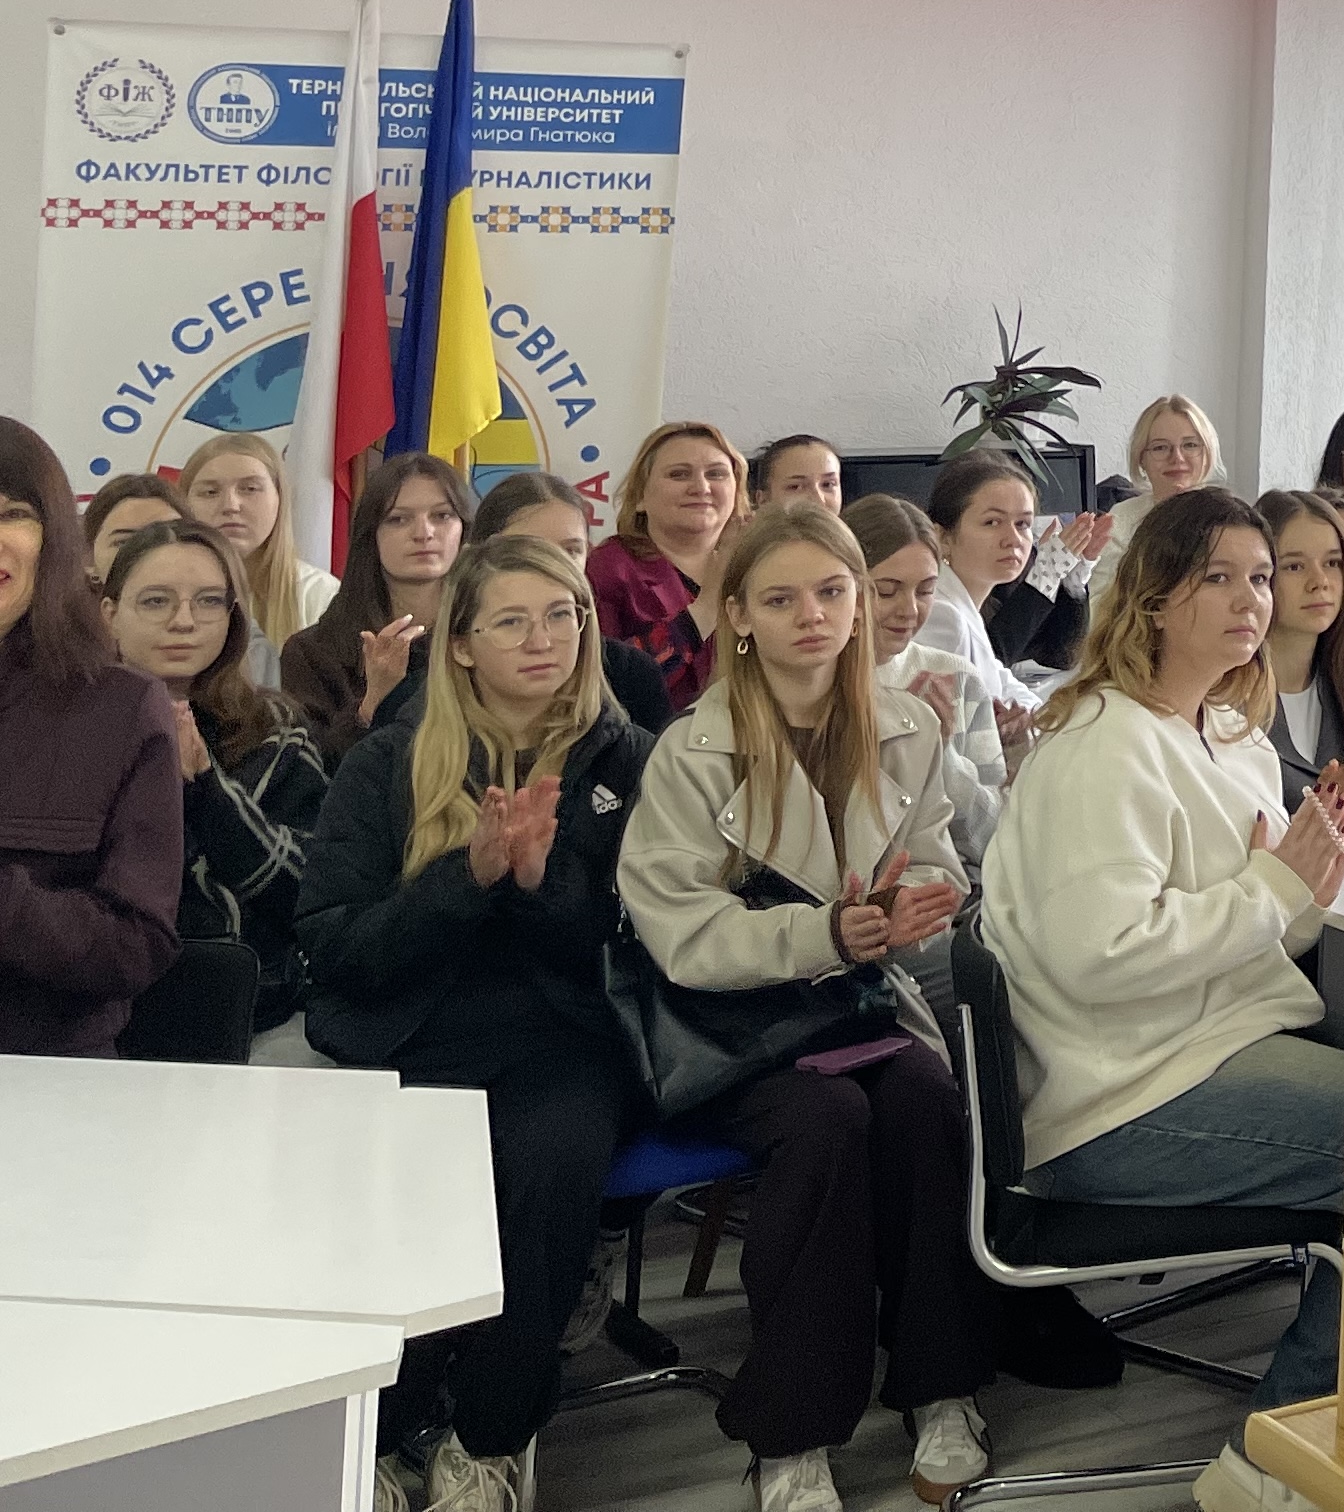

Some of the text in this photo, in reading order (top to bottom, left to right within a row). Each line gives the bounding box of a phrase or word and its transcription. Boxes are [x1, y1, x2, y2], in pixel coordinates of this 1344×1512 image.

[489, 86, 655, 105] НАЦІОНАЛЬНИЙ
[200, 106, 270, 127] ТНПУ
[489, 106, 624, 124] УНІВЕРСИТЕТ
[387, 122, 524, 144] Волмира
[530, 127, 616, 144] Гнатюка
[75, 159, 249, 184] ФАКУЛЬТЕТ
[256, 162, 413, 187] ФІЛОГІЇ
[471, 169, 652, 191] РНАЛІСТИКИ
[102, 360, 175, 434] 014
